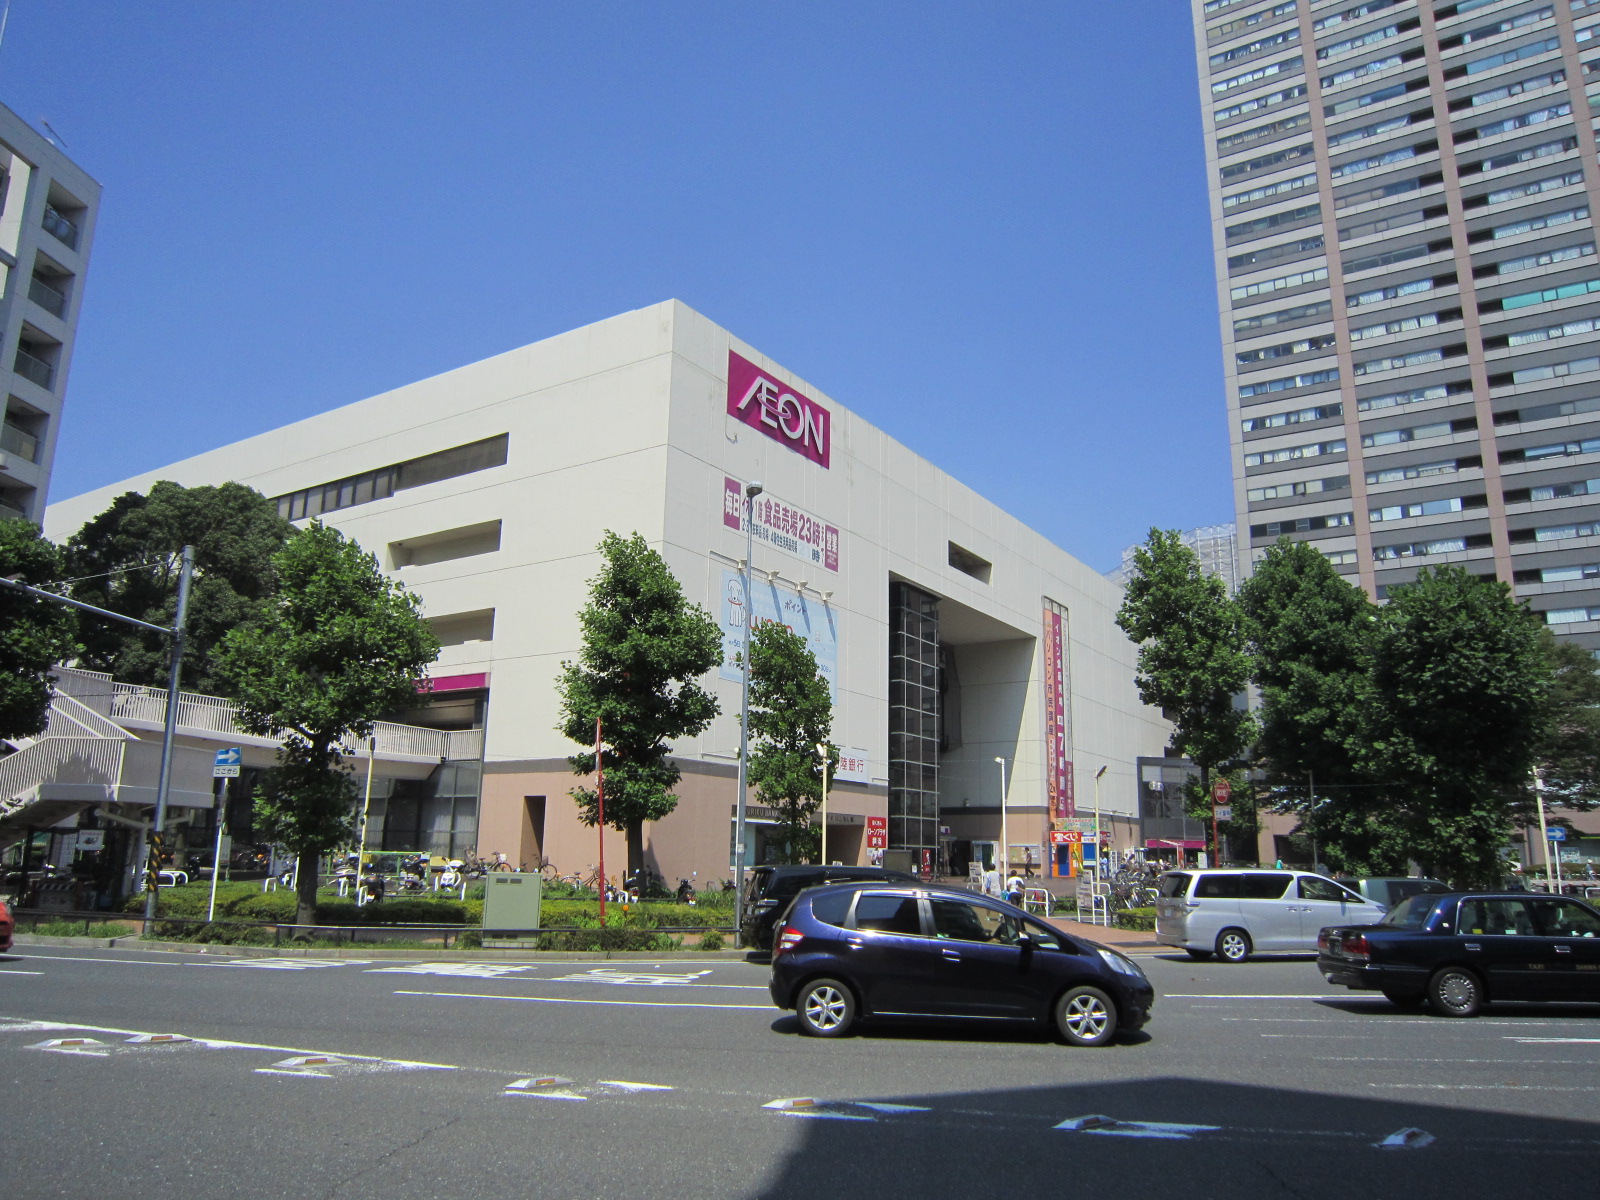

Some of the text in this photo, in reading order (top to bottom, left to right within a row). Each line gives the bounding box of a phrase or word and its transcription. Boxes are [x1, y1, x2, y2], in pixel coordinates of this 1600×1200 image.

[726, 488, 740, 518] 毎日
[784, 600, 806, 614] ポイント
[1054, 833, 1079, 842] 宝くじ
